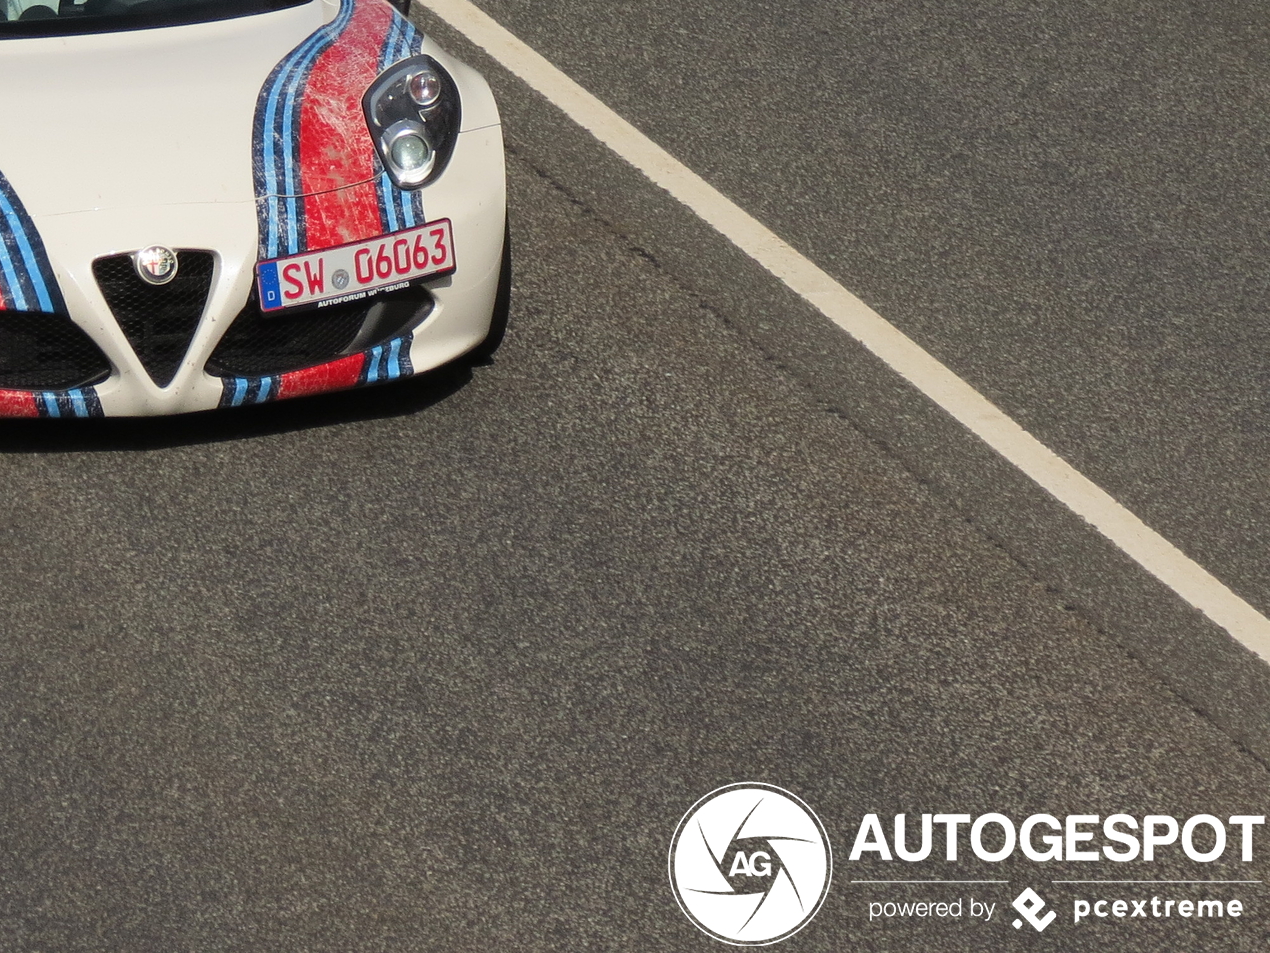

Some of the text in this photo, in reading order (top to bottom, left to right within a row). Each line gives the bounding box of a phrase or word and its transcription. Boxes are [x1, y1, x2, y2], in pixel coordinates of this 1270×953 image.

[282, 228, 447, 299] SW 06063
[267, 290, 276, 302] D
[317, 291, 367, 308] AUTOFORUM
